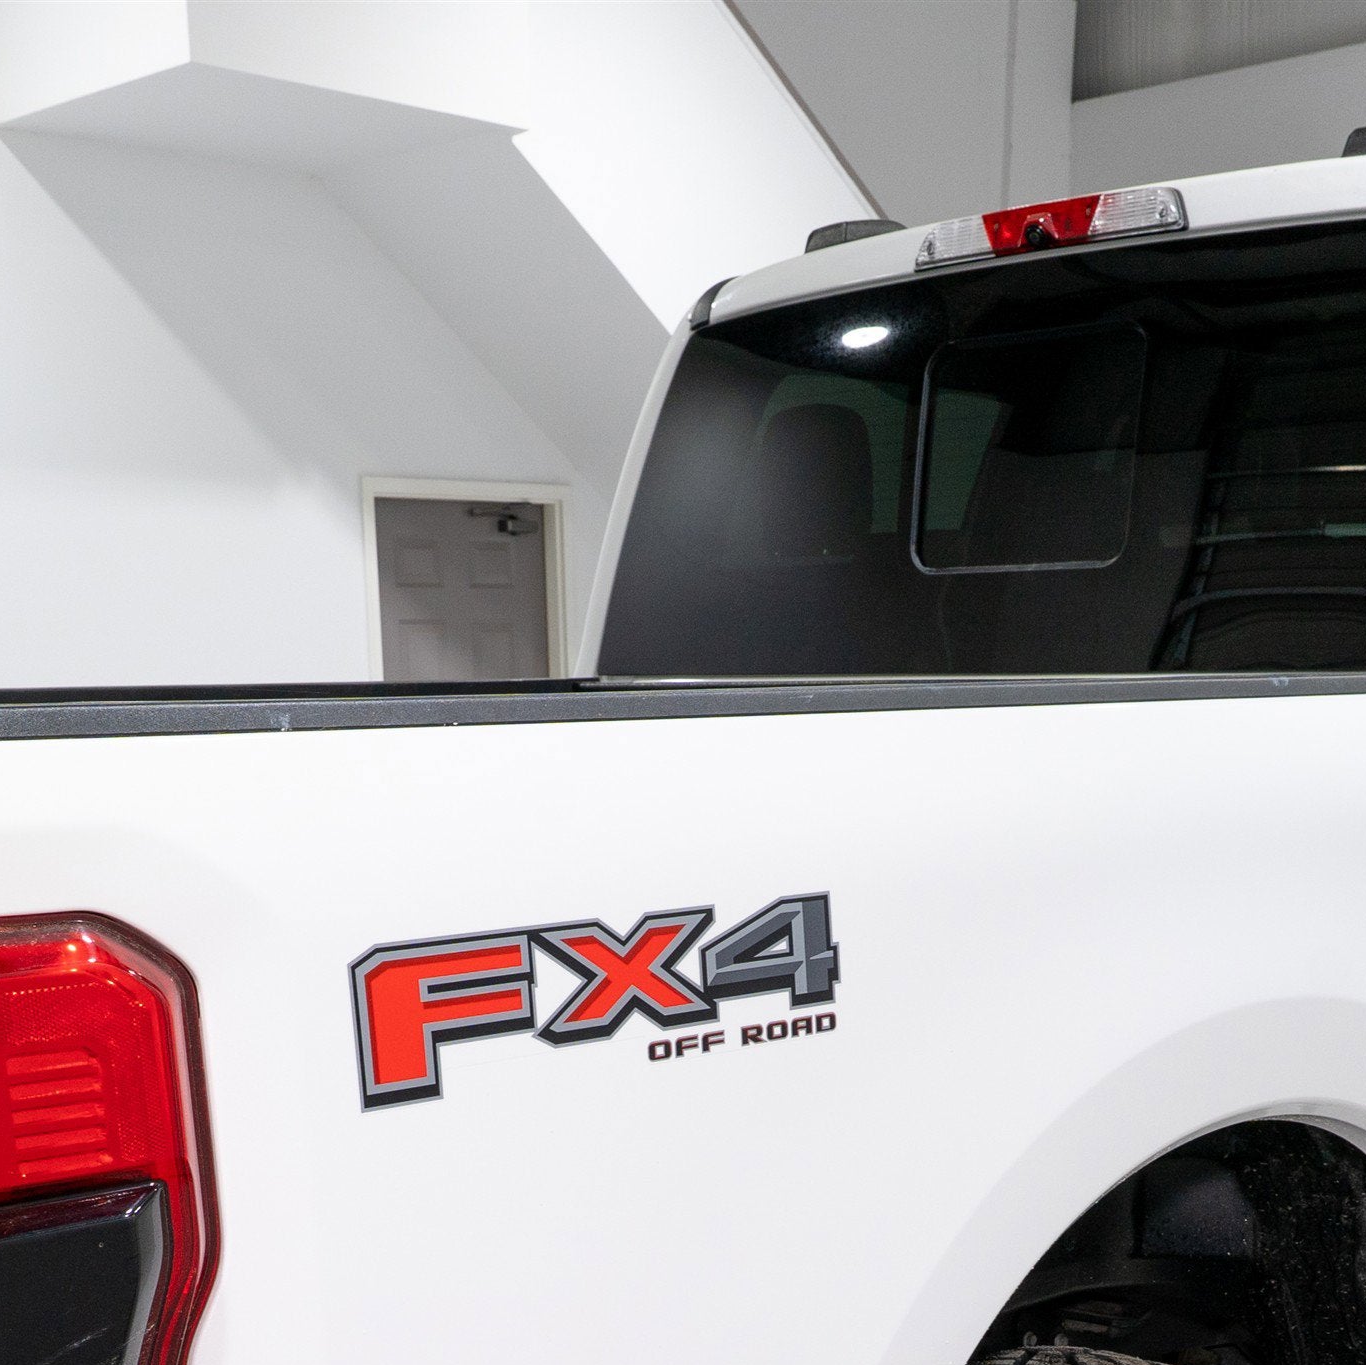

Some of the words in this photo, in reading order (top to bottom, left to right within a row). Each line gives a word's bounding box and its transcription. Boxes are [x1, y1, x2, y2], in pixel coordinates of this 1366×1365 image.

[347, 890, 840, 1113] FX4
[647, 1029, 726, 1063] OFF
[740, 1011, 837, 1047] ROAD
